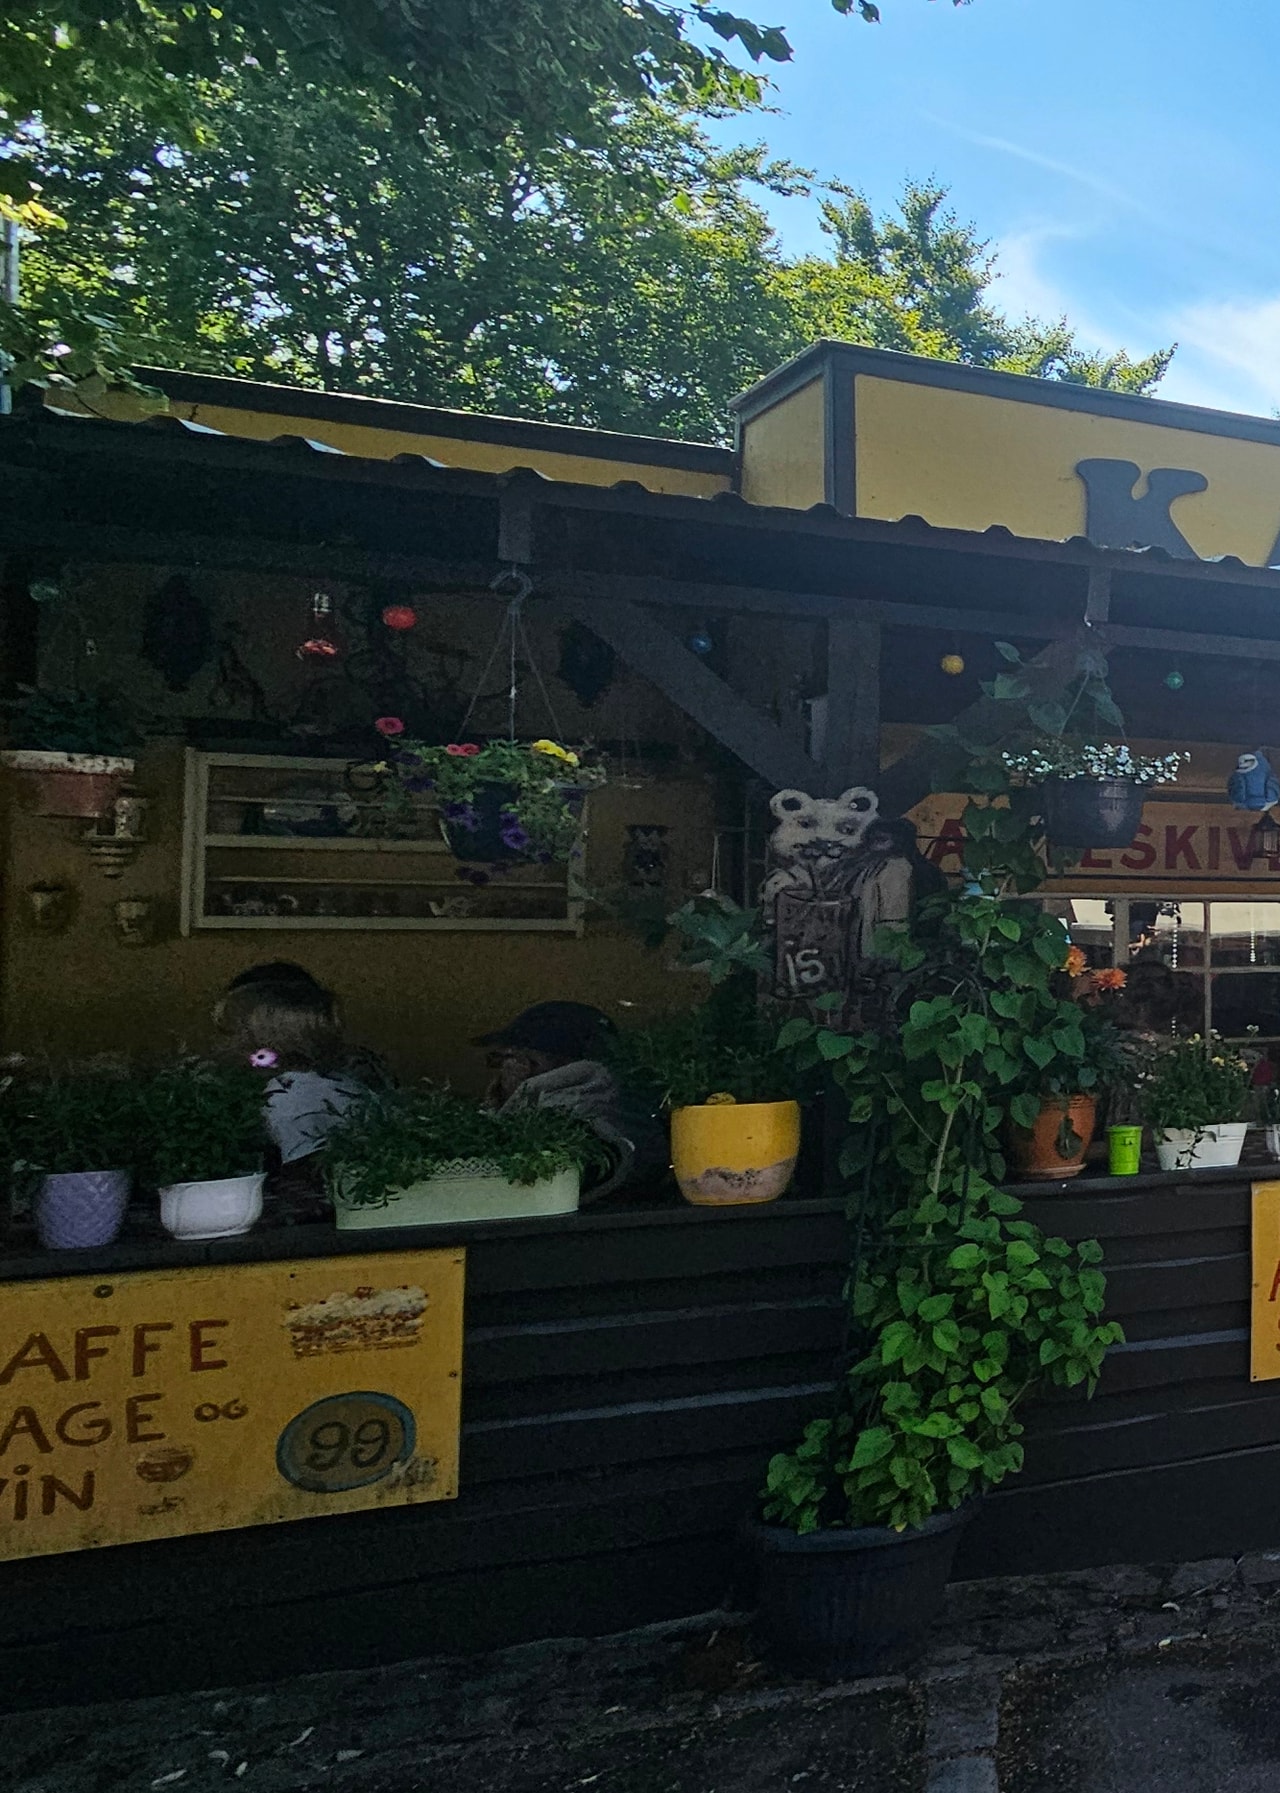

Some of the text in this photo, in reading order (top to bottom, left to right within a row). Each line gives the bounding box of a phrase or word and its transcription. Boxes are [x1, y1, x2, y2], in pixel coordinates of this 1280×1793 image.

[0, 1319, 229, 1386] AFFE
[0, 1392, 167, 1454] AGE
[304, 1418, 391, 1473] 99
[0, 1462, 96, 1522] iN
